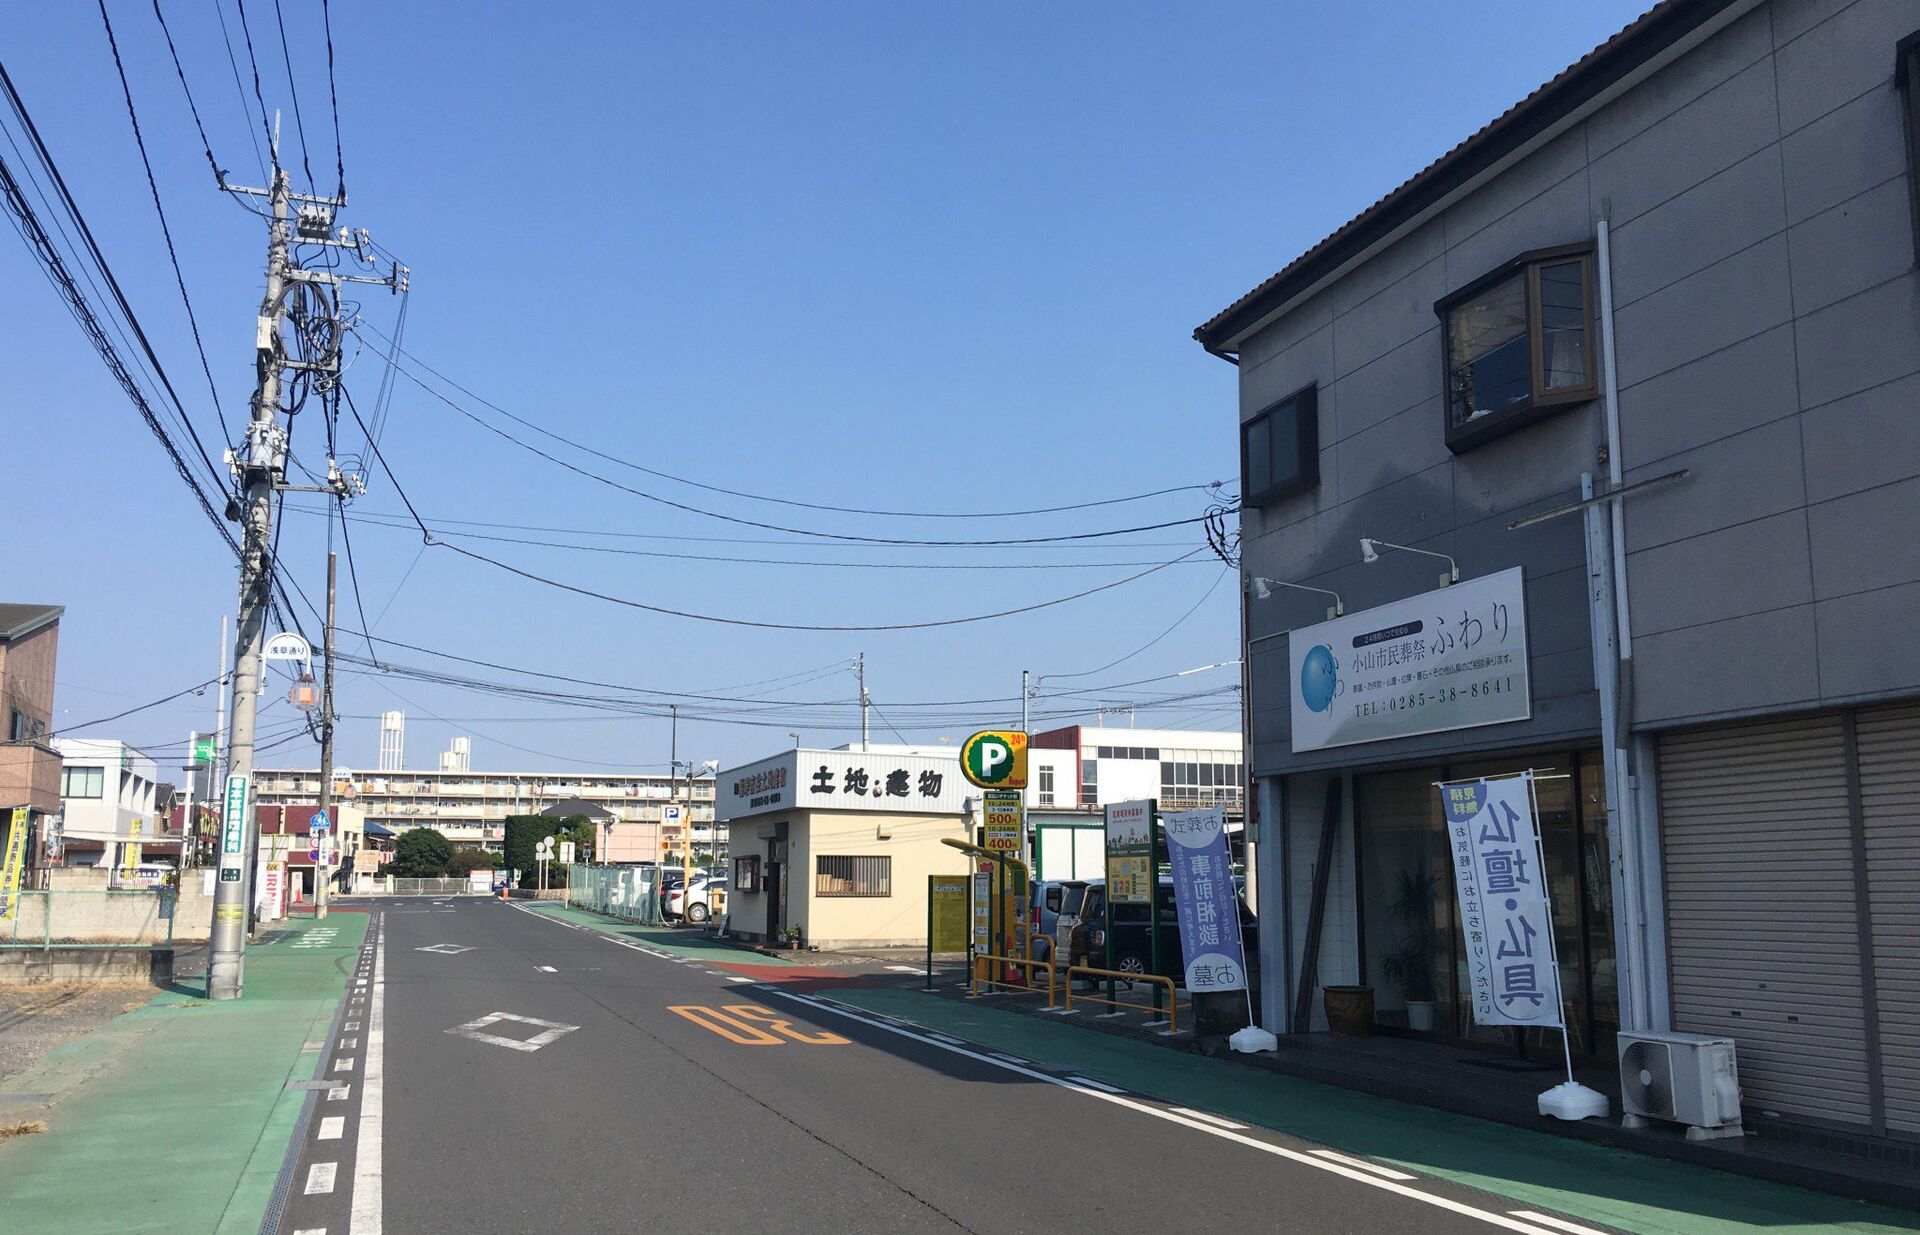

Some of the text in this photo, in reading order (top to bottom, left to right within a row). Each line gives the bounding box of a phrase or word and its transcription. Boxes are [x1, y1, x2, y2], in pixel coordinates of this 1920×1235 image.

[1431, 601, 1509, 655] ふわり
[270, 646, 305, 655] 浅草通り
[1352, 638, 1426, 674] 小山市民葬祭
[982, 742, 1007, 777] P
